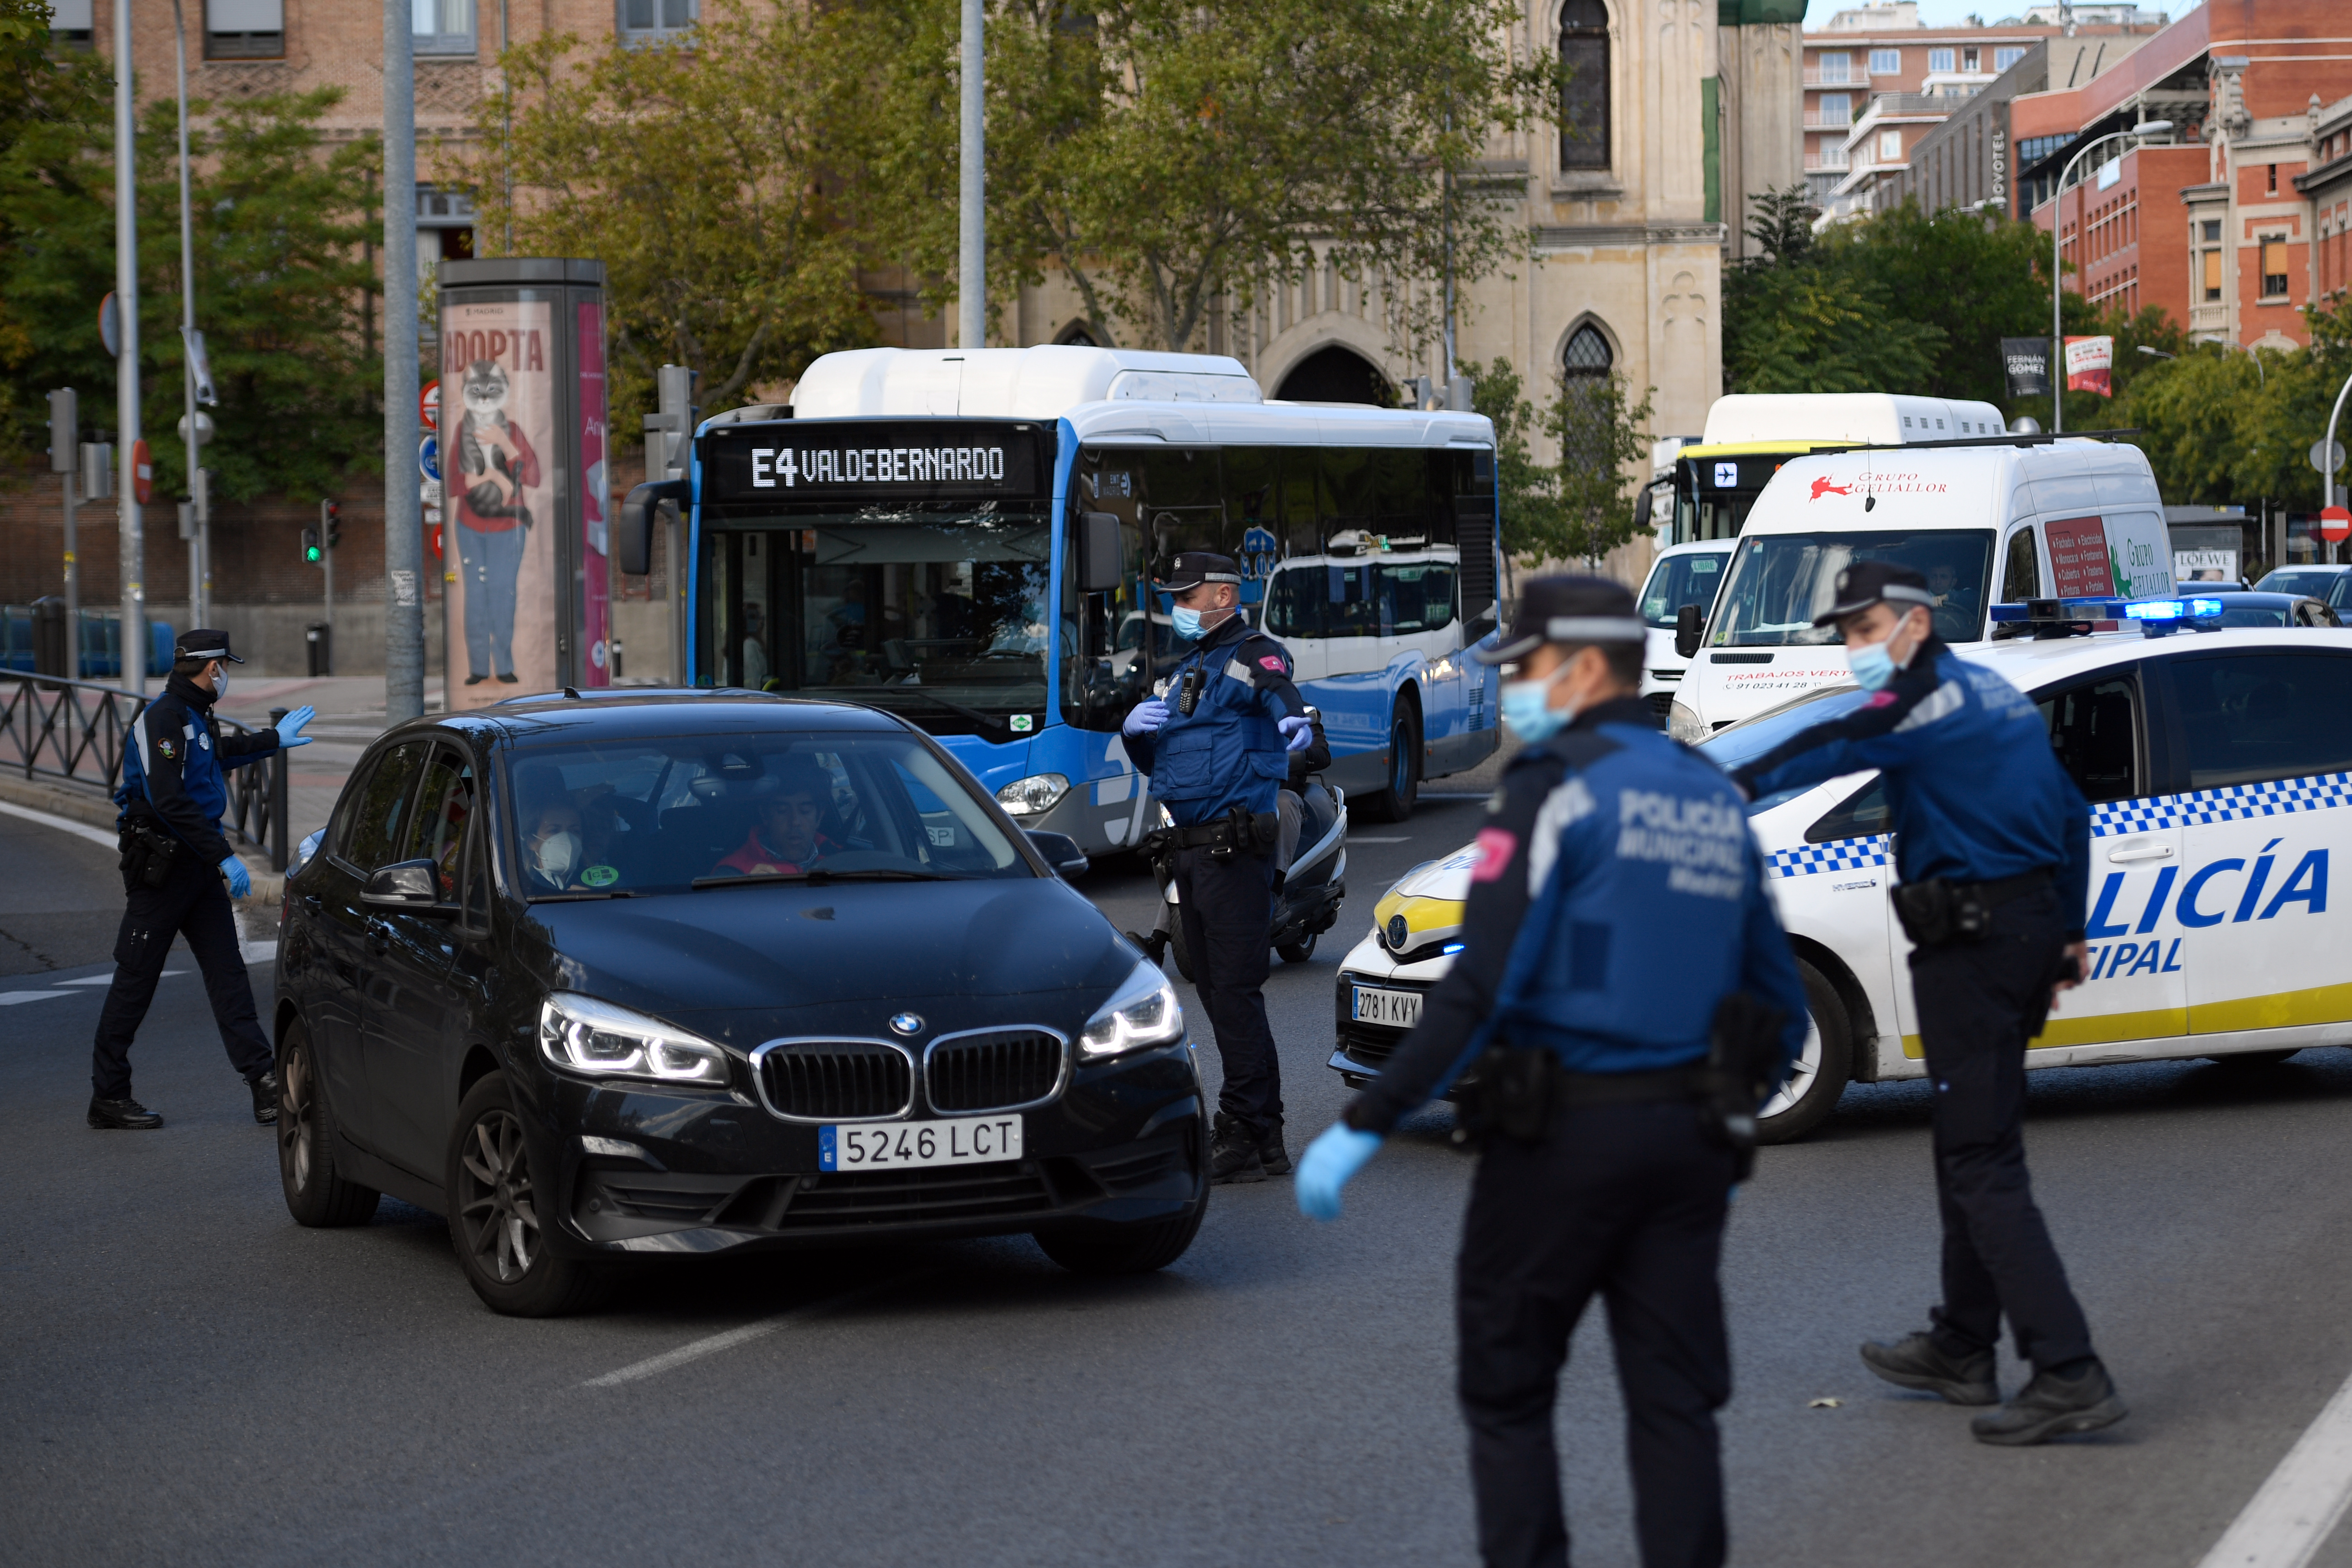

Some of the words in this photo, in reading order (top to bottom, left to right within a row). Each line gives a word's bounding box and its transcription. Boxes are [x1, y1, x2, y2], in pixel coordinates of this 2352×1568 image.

[1993, 130, 2005, 197] OVOTEL
[444, 329, 543, 373] ADOPTA
[2007, 353, 2045, 365] FERNÁN
[752, 448, 799, 487] E4
[802, 448, 1004, 482] VALDEBERNARDO
[1110, 474, 1120, 484] EMT
[1859, 472, 1918, 481] GRUPO
[1855, 483, 1947, 493] GELIALLOR
[2055, 537, 2075, 548] Fachadas
[2080, 533, 2103, 546] Electricidad
[2127, 538, 2153, 567] GRUPO
[2180, 552, 2230, 567] LOEWE
[1694, 562, 1715, 571] LIBRE
[2086, 566, 2104, 577] Trasteros
[2061, 569, 2080, 580] Cubiertas
[2064, 585, 2080, 596] Pinturas
[2088, 582, 2104, 592] Portales
[2133, 572, 2171, 598] GELIALLOR
[1727, 670, 1805, 681] TRABAJOS
[1618, 788, 1743, 838] POLICÍA
[1616, 827, 1743, 872] MUNICIPAL
[2085, 837, 2329, 940] LICÍA
[1359, 992, 1385, 1020] 2781
[1391, 996, 1417, 1023] KVY
[847, 1128, 935, 1163] 5246
[951, 1121, 1012, 1157] LCT
[824, 1152, 831, 1162] E
